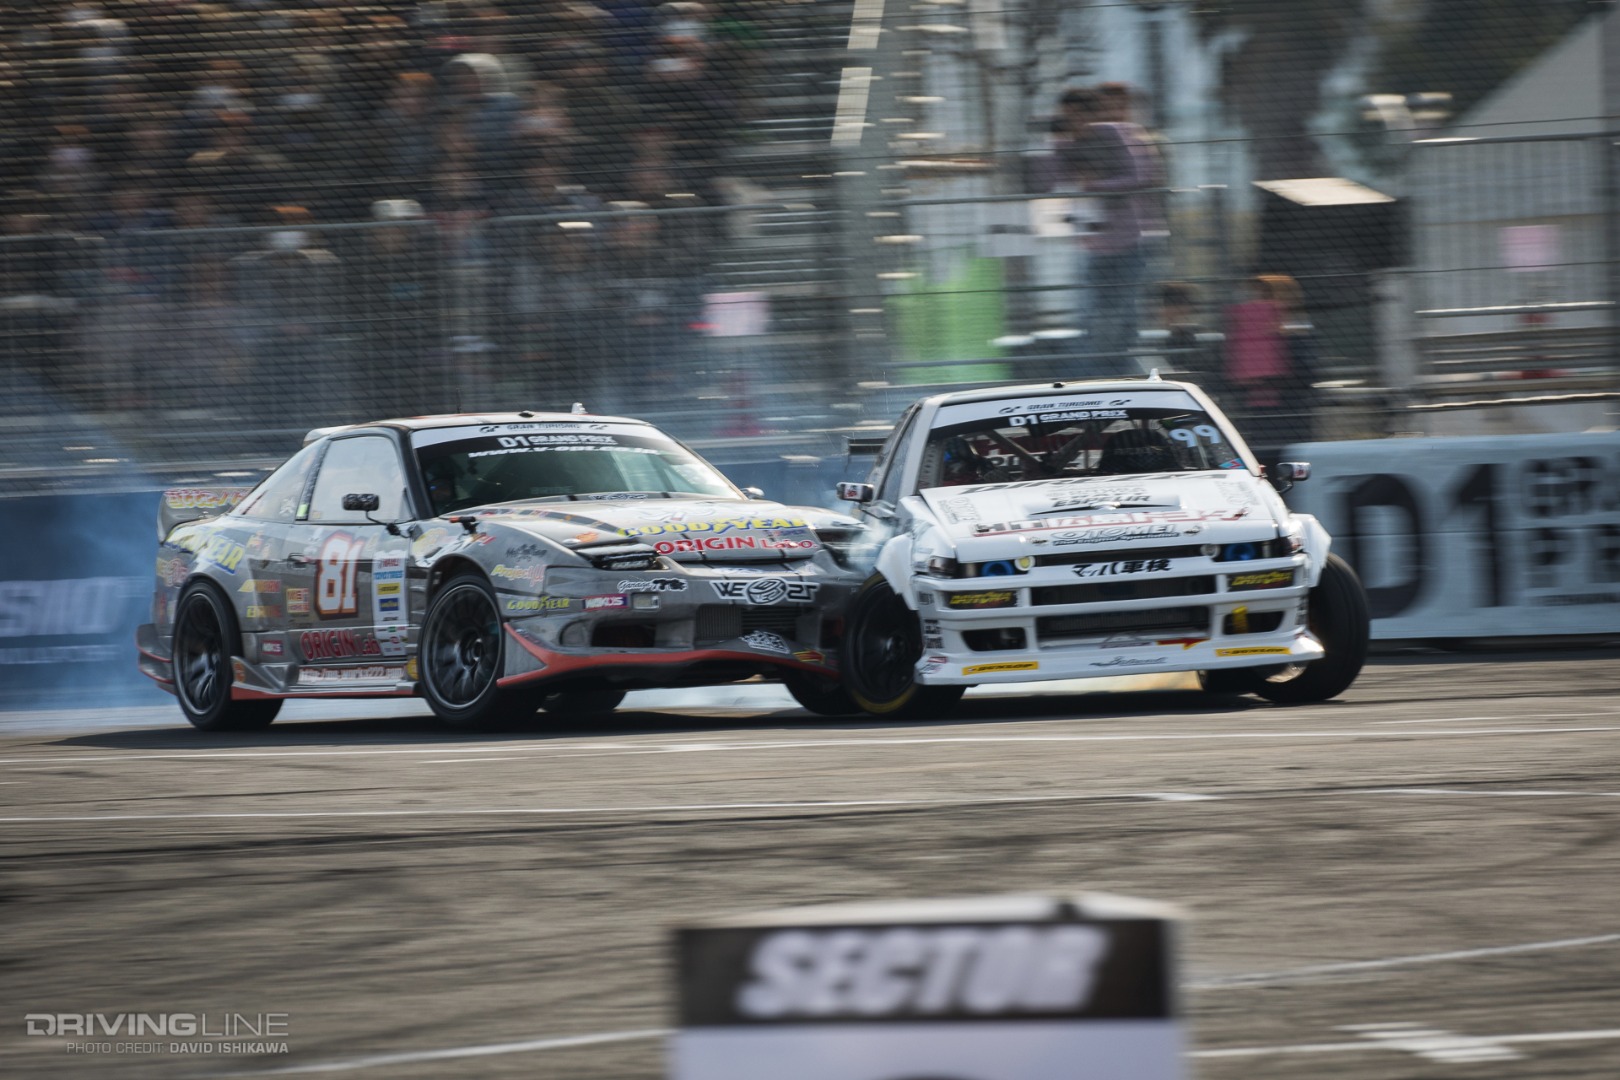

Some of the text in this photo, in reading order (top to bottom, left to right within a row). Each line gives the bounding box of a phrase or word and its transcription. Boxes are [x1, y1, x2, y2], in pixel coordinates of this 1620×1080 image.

[1058, 400, 1103, 408] TURISMO
[1009, 409, 1127, 427] D1 GRAND PRIX
[497, 434, 617, 447] D1 GRAND PRIX
[1169, 424, 1222, 448] 99
[653, 535, 756, 555] ORIGIN
[316, 531, 363, 615] 81
[507, 596, 570, 611] GOODYEAR
[301, 629, 355, 660] ORIGIN
[735, 922, 1109, 1016] SECTOR
